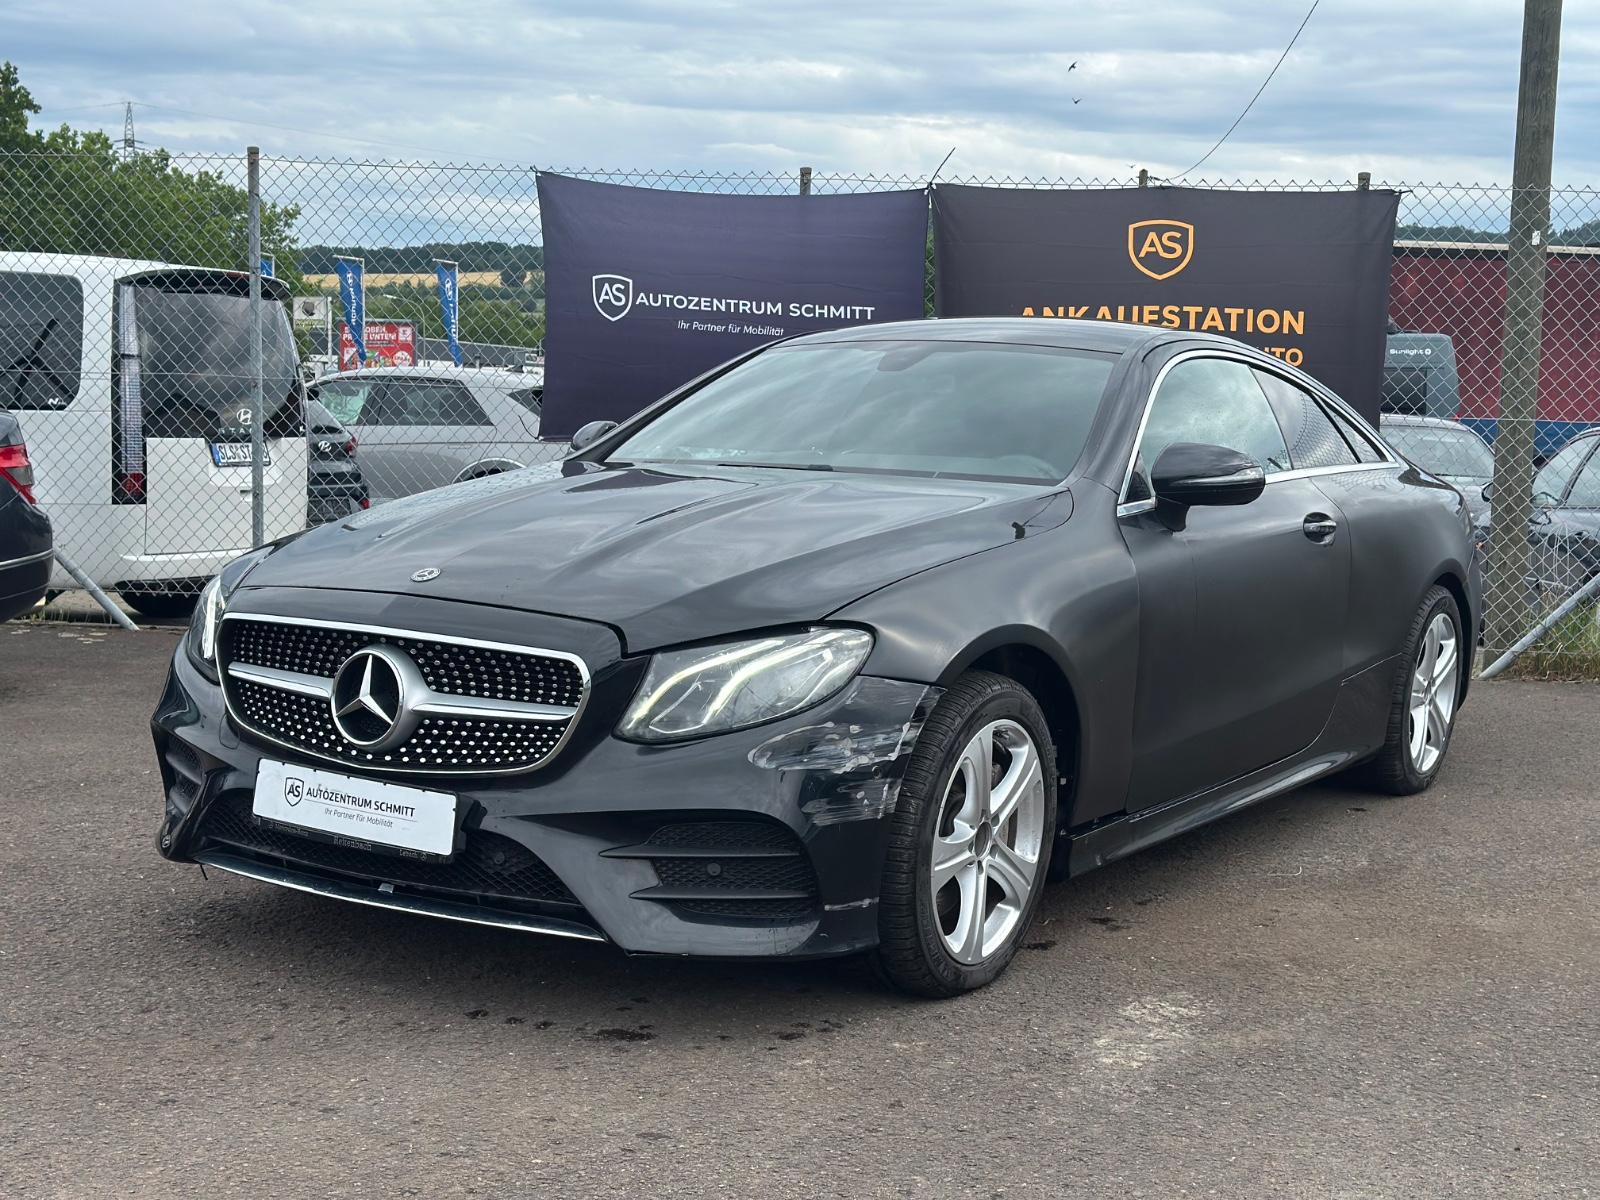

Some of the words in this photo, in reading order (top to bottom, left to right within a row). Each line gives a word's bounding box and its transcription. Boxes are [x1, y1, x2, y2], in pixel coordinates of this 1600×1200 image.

[1138, 231, 1183, 259] AS
[598, 282, 626, 307] AS
[635, 292, 783, 316] AUTOZENTRUM
[788, 303, 875, 320] SCHMITT
[677, 319, 690, 330] Ihr
[692, 320, 726, 333] Partner
[728, 323, 741, 334] für
[743, 324, 784, 337] Mobilität
[1389, 348, 1424, 356] Sunlight
[287, 783, 301, 798] AS
[306, 786, 372, 810] AUTOZENTRUM
[374, 800, 415, 818] SCHMITT
[324, 807, 333, 816] Ihr
[333, 809, 355, 821] Partner
[355, 813, 366, 822] für
[366, 815, 393, 829] Mobilität
